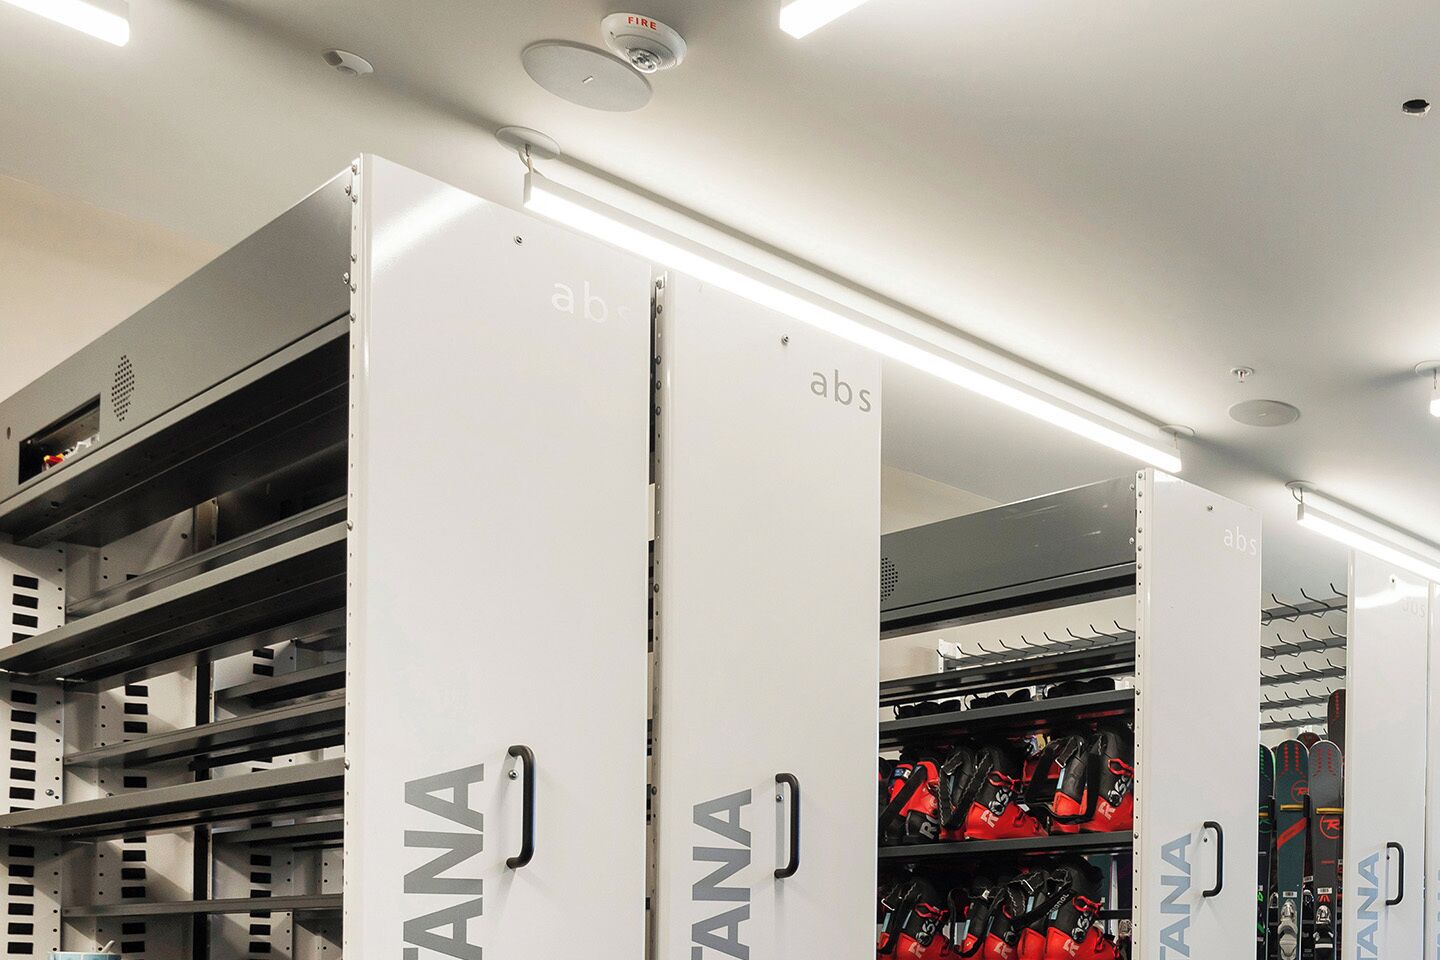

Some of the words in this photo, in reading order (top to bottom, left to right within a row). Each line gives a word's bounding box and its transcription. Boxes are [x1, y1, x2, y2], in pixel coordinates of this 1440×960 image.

[627, 16, 657, 30] FIRE
[810, 369, 872, 413] abs
[1223, 526, 1257, 556] abs
